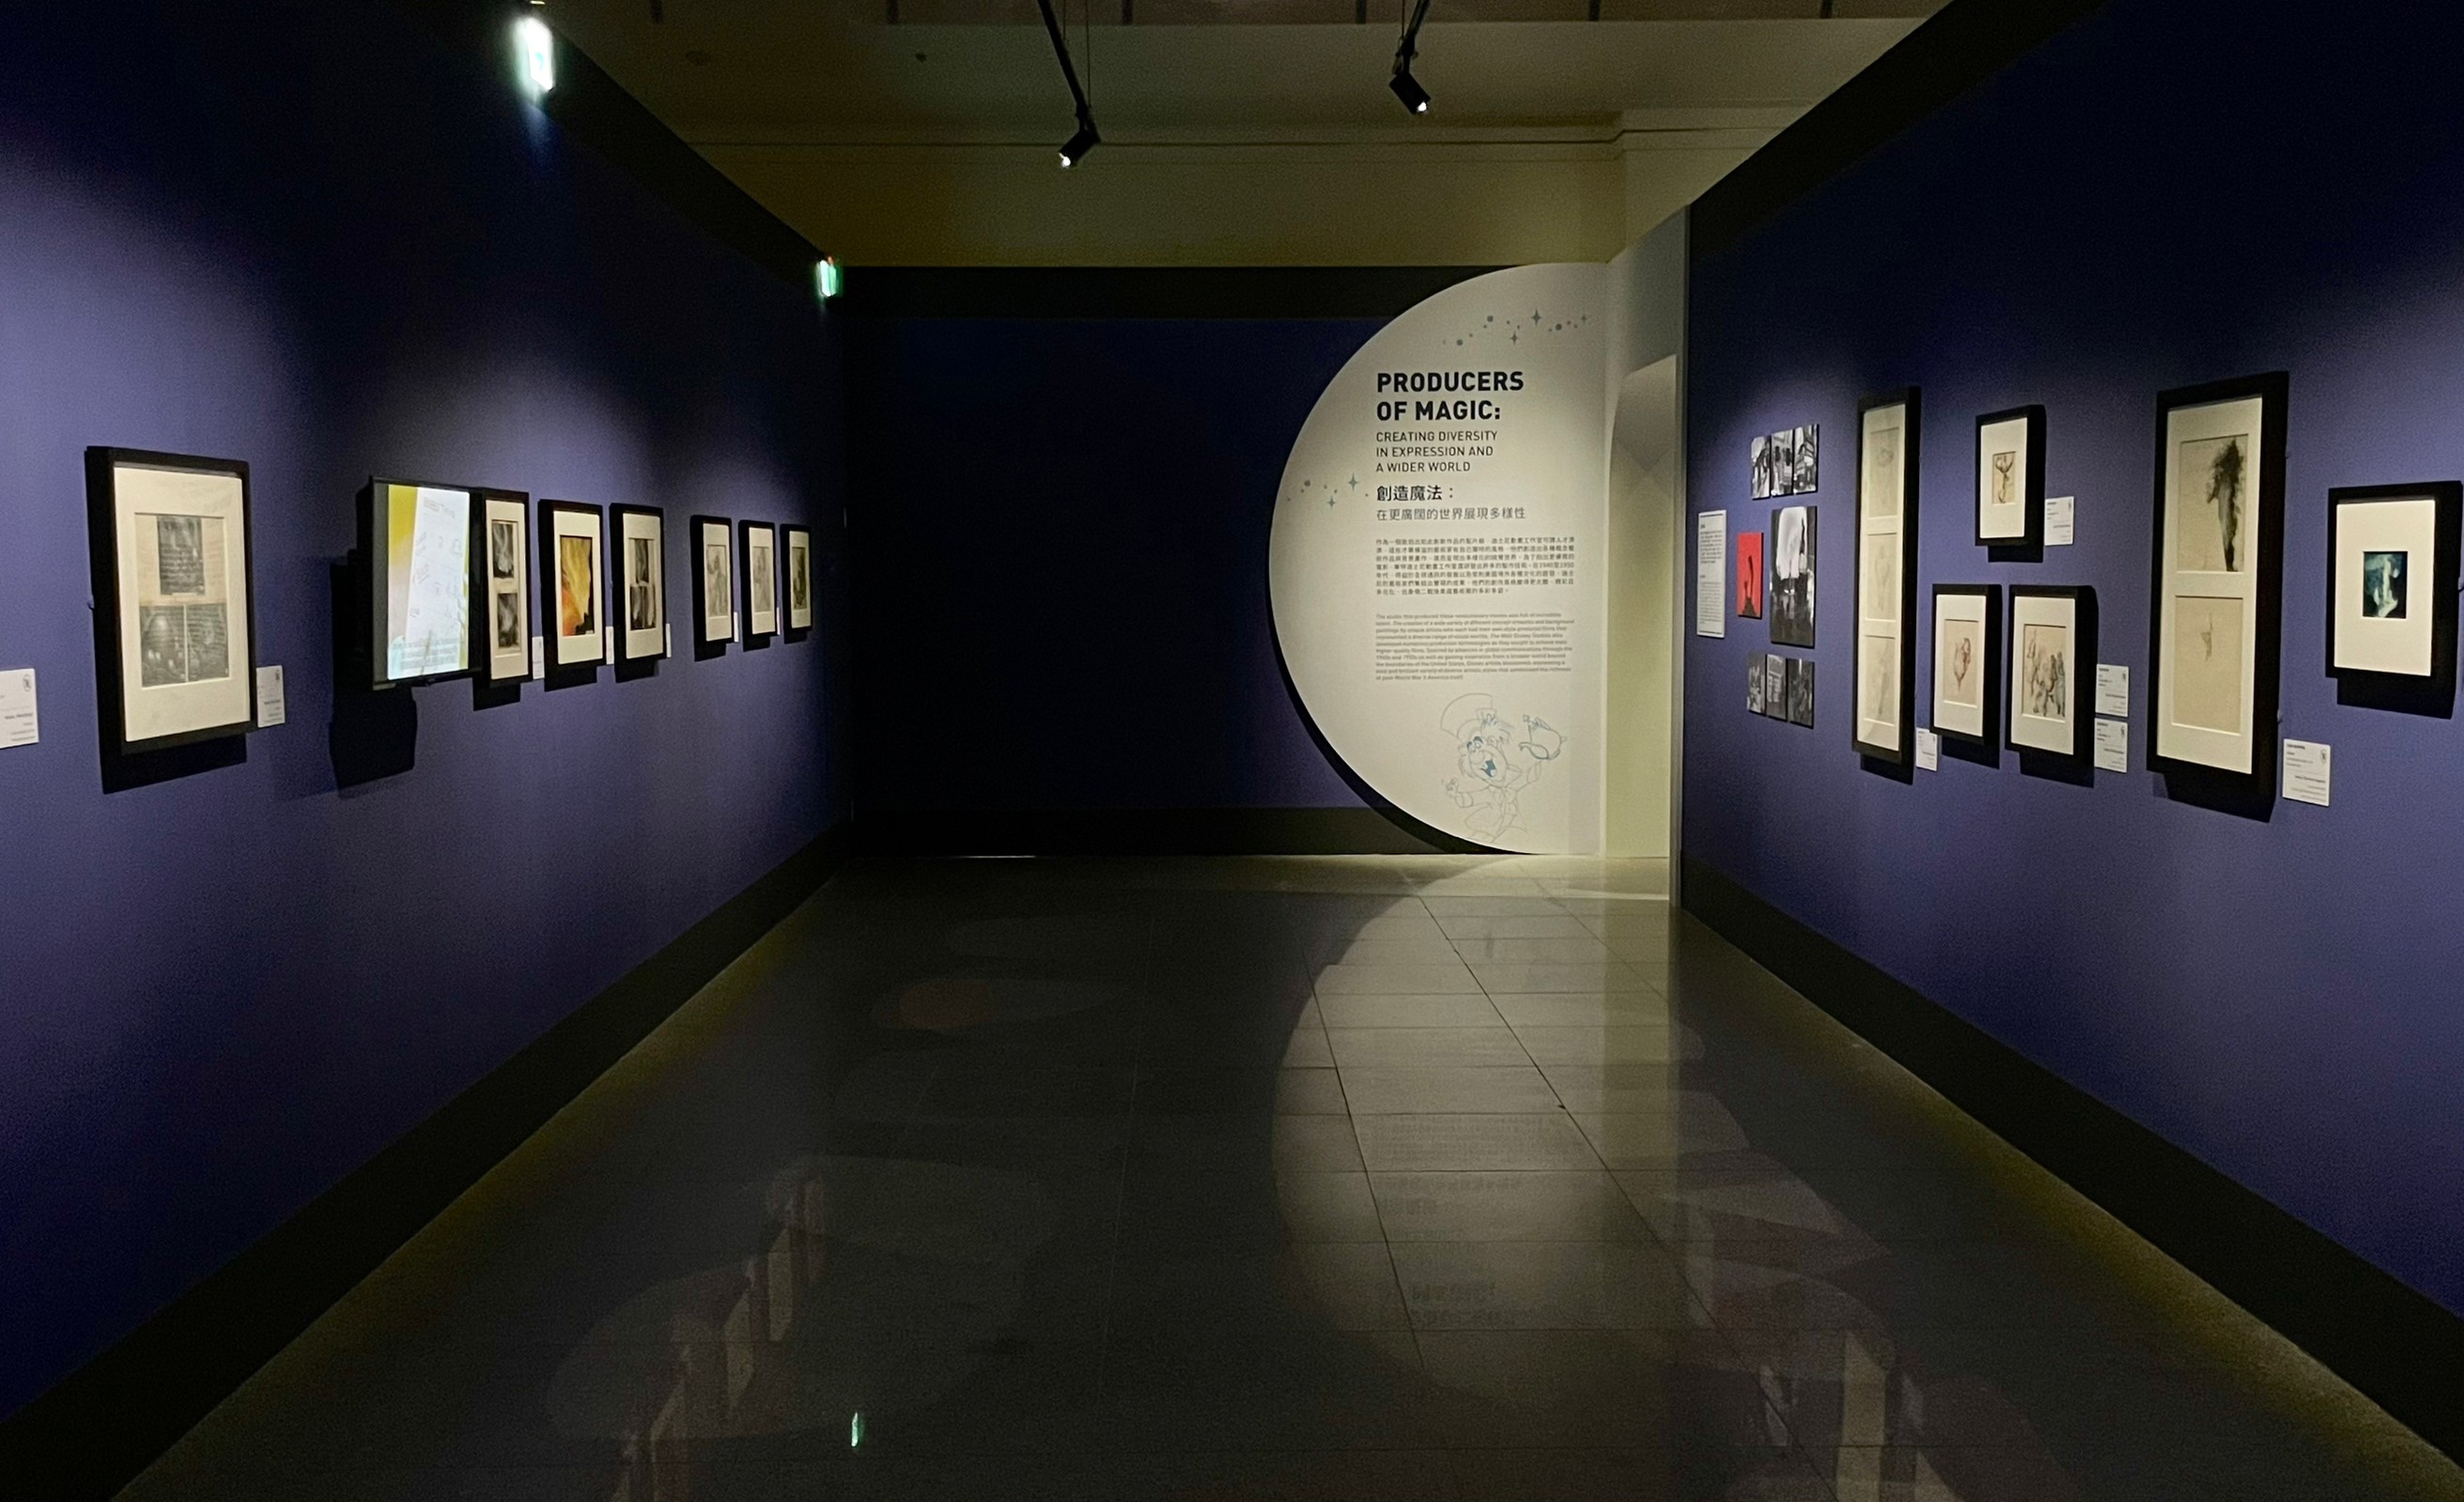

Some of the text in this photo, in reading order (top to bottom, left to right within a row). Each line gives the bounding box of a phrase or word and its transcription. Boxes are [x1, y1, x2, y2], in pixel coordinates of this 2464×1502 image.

[1377, 371, 1524, 393] PRODUCERS
[1376, 400, 1500, 421] OF MAGIC:
[1376, 430, 1498, 442] CREATING DIVERSITY
[1376, 446, 1494, 457] IN EXPRESSION AND
[1375, 461, 1471, 472] A WIDER WORLD
